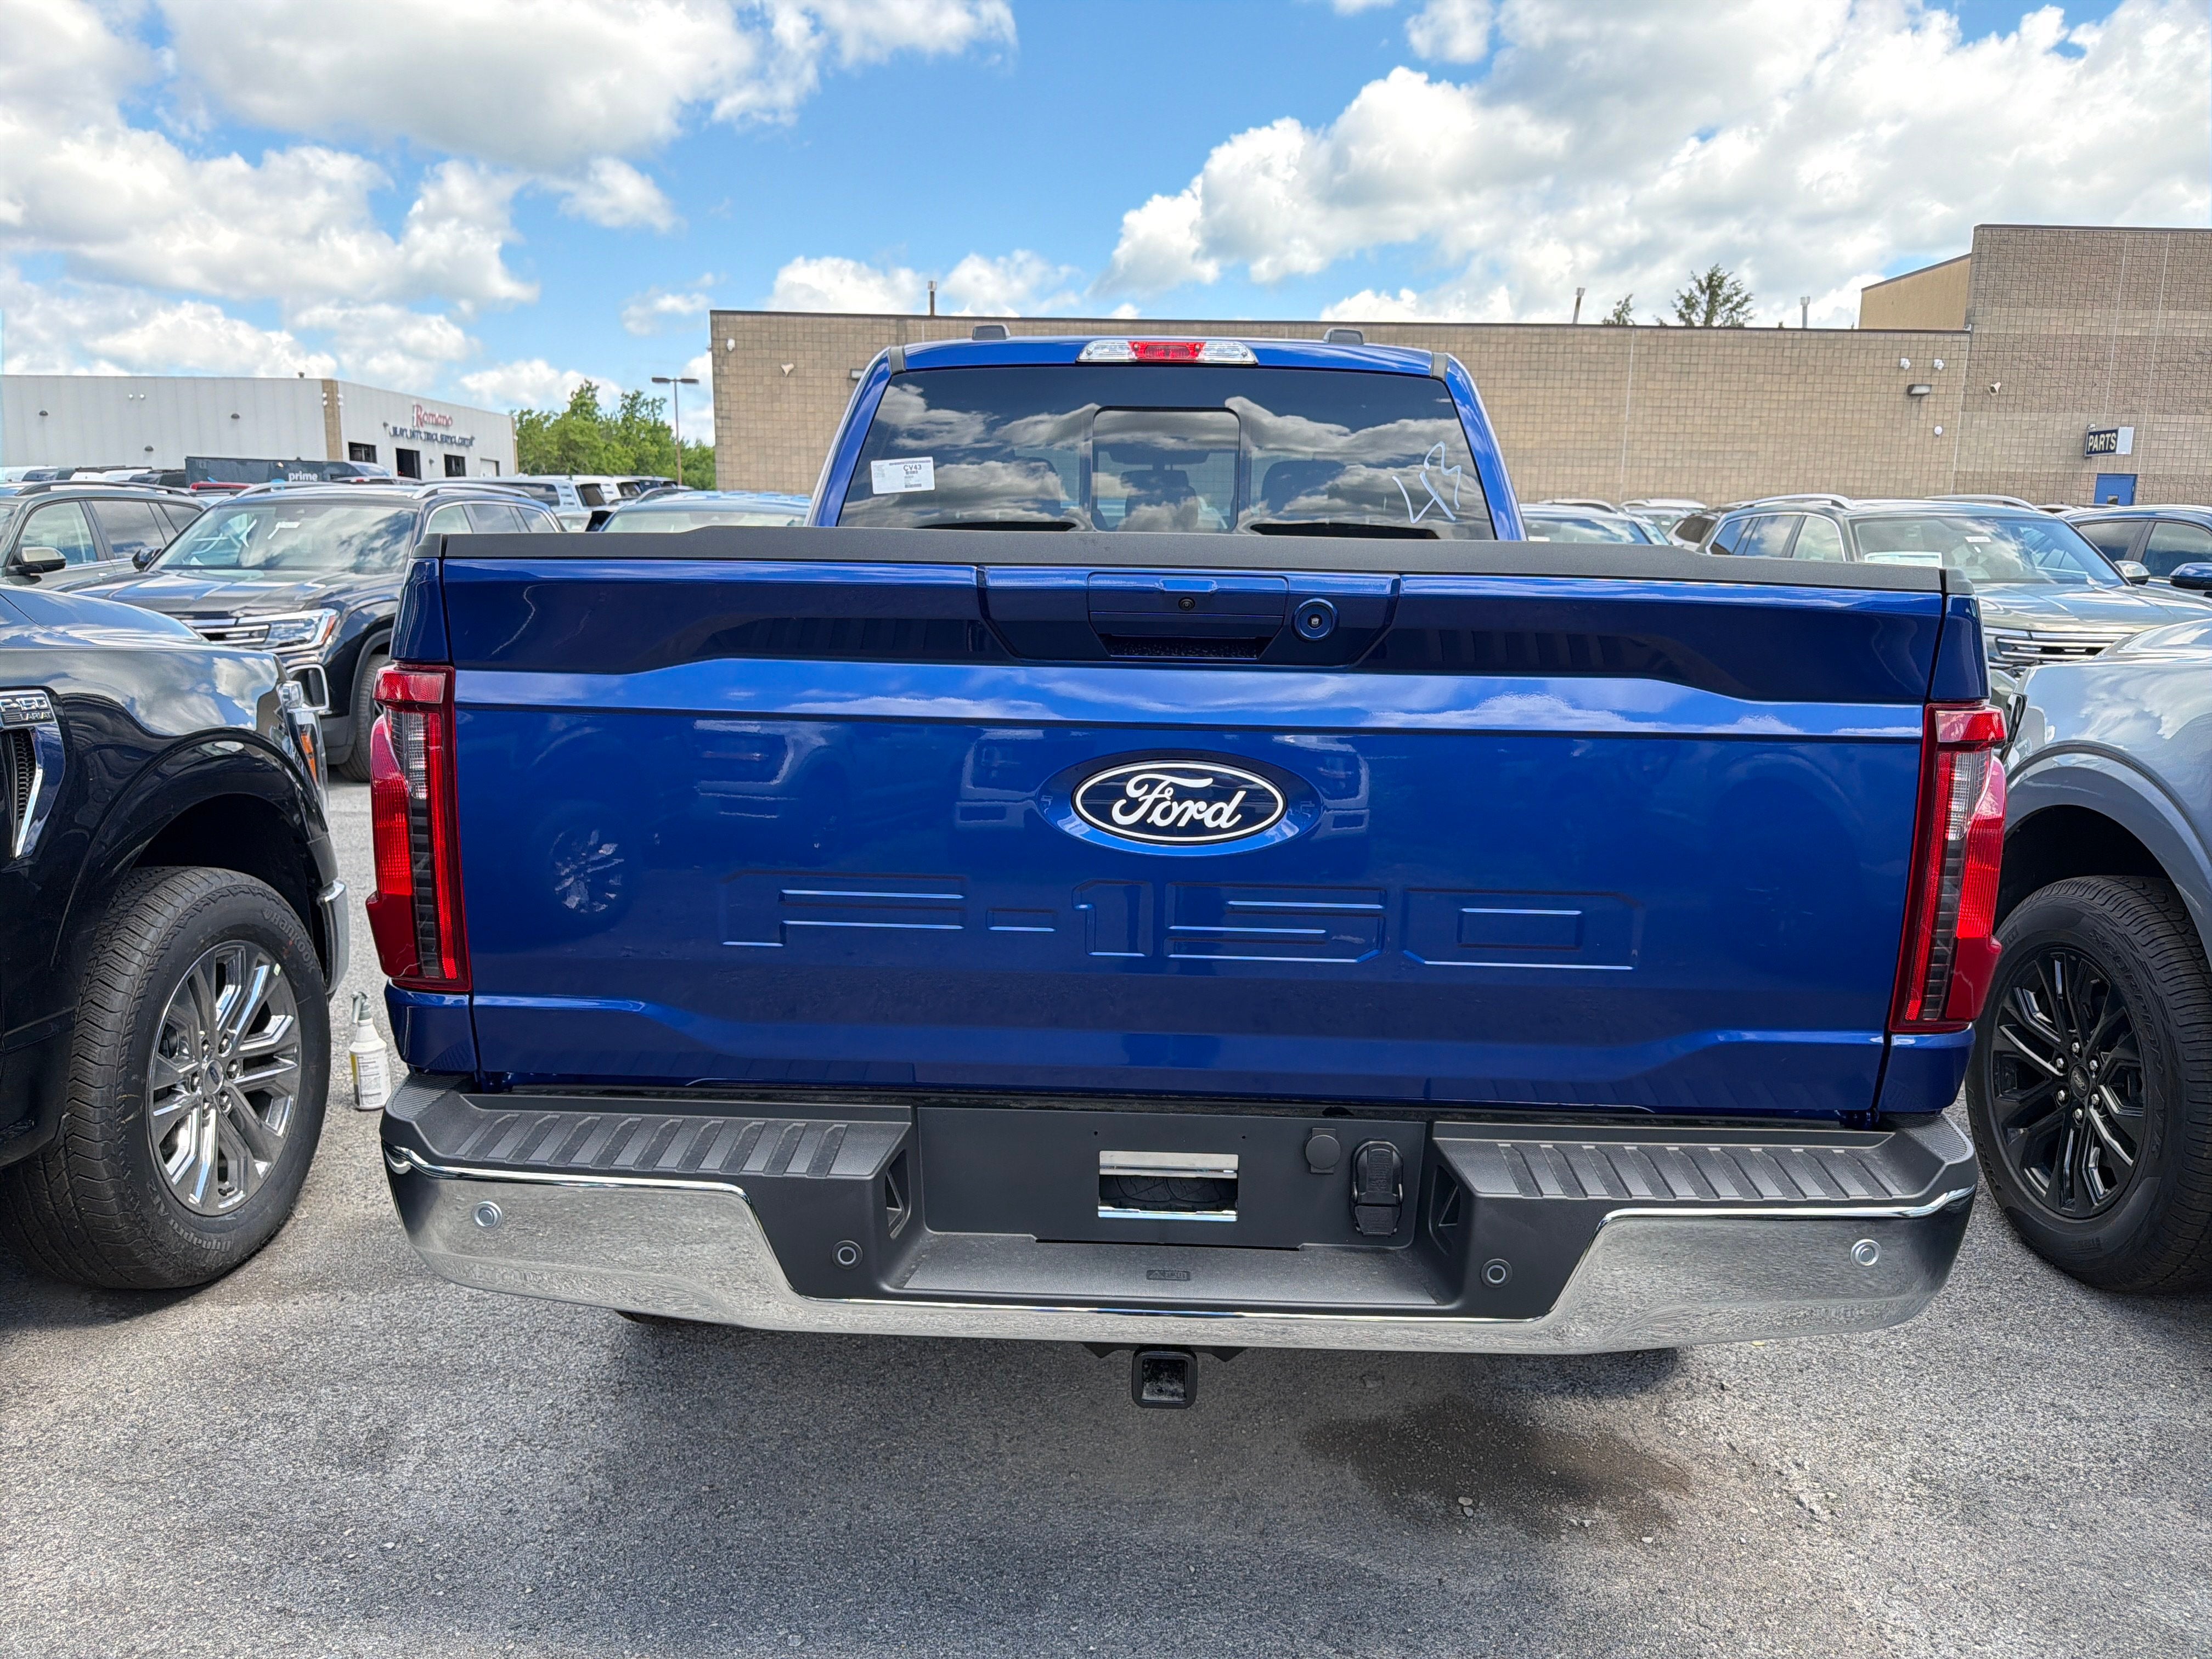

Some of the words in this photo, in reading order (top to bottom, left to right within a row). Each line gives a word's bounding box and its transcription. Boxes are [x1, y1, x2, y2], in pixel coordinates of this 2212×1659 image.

[414, 403, 453, 427] Romano
[2087, 432, 2117, 452] PARTS
[288, 470, 318, 482] prime
[20, 712, 52, 721] LARIAT
[1111, 774, 1246, 829] Ford
[720, 869, 1637, 972] F-150
[168, 1218, 232, 1252] Dynapro
